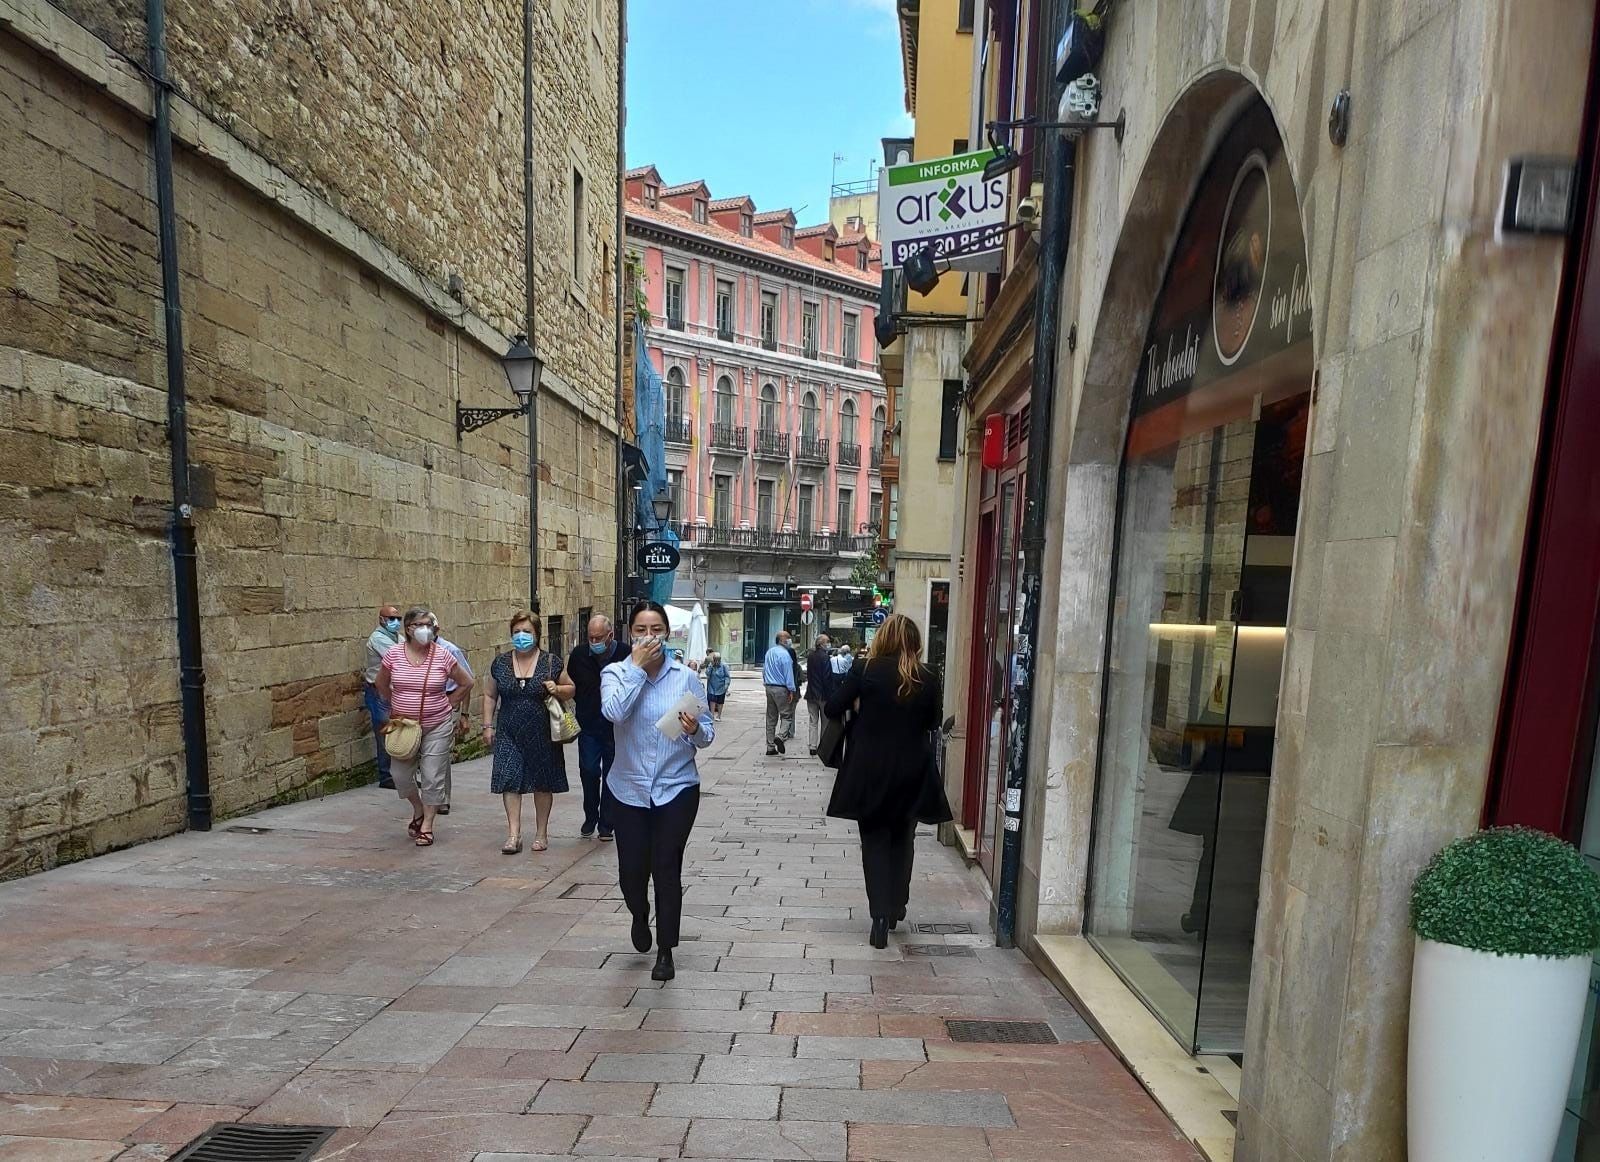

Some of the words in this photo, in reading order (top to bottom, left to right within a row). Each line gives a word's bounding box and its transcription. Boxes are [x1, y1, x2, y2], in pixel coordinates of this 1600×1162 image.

[919, 158, 980, 178] INFORMA
[934, 237, 956, 257] 20
[1146, 343, 1160, 397] The
[645, 553, 671, 564] FÉLIX
